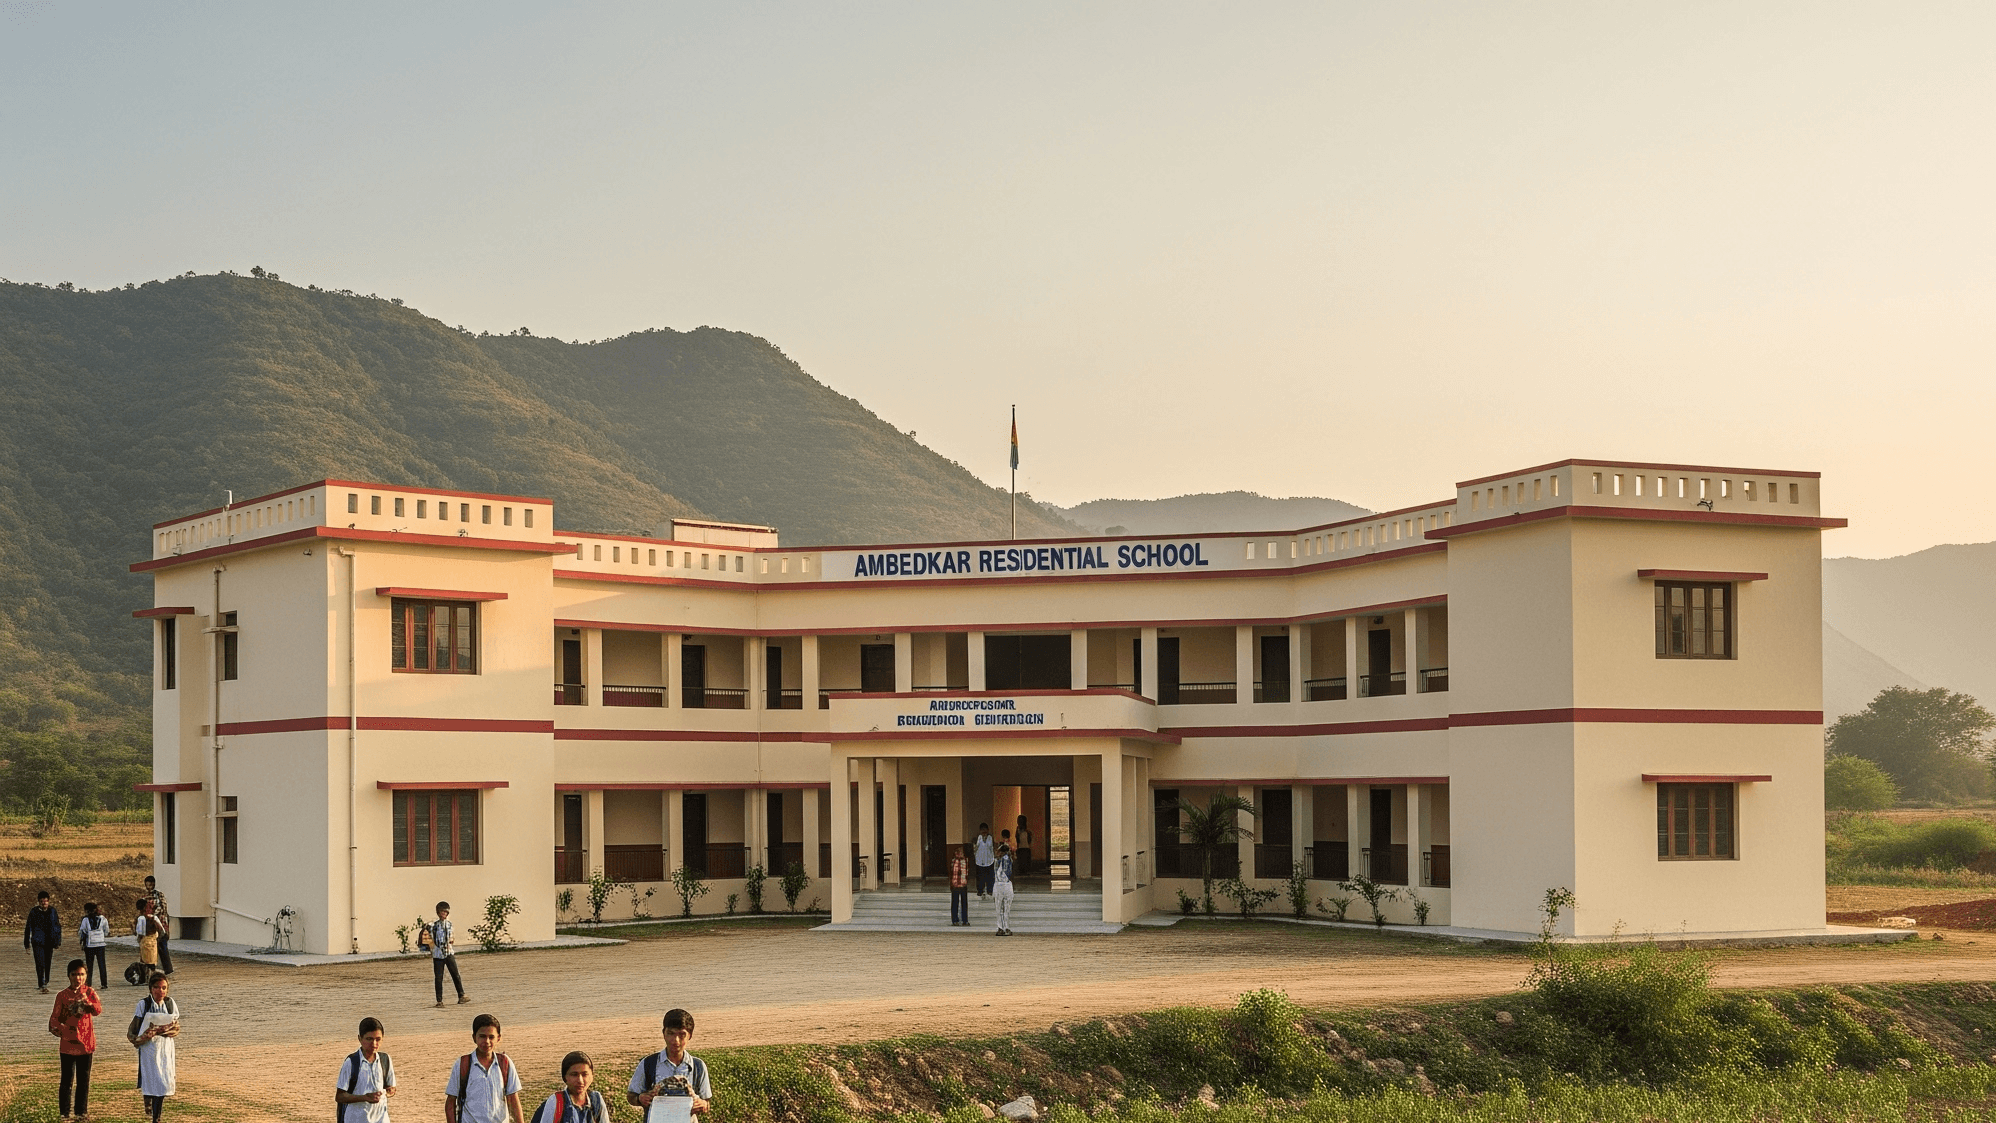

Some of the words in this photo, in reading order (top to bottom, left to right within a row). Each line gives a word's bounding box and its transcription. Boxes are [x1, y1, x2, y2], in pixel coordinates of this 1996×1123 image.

[854, 551, 971, 577] AMBEDKAR
[979, 546, 1109, 572] RESIDENTIAL
[1117, 543, 1209, 569] SCHOOL
